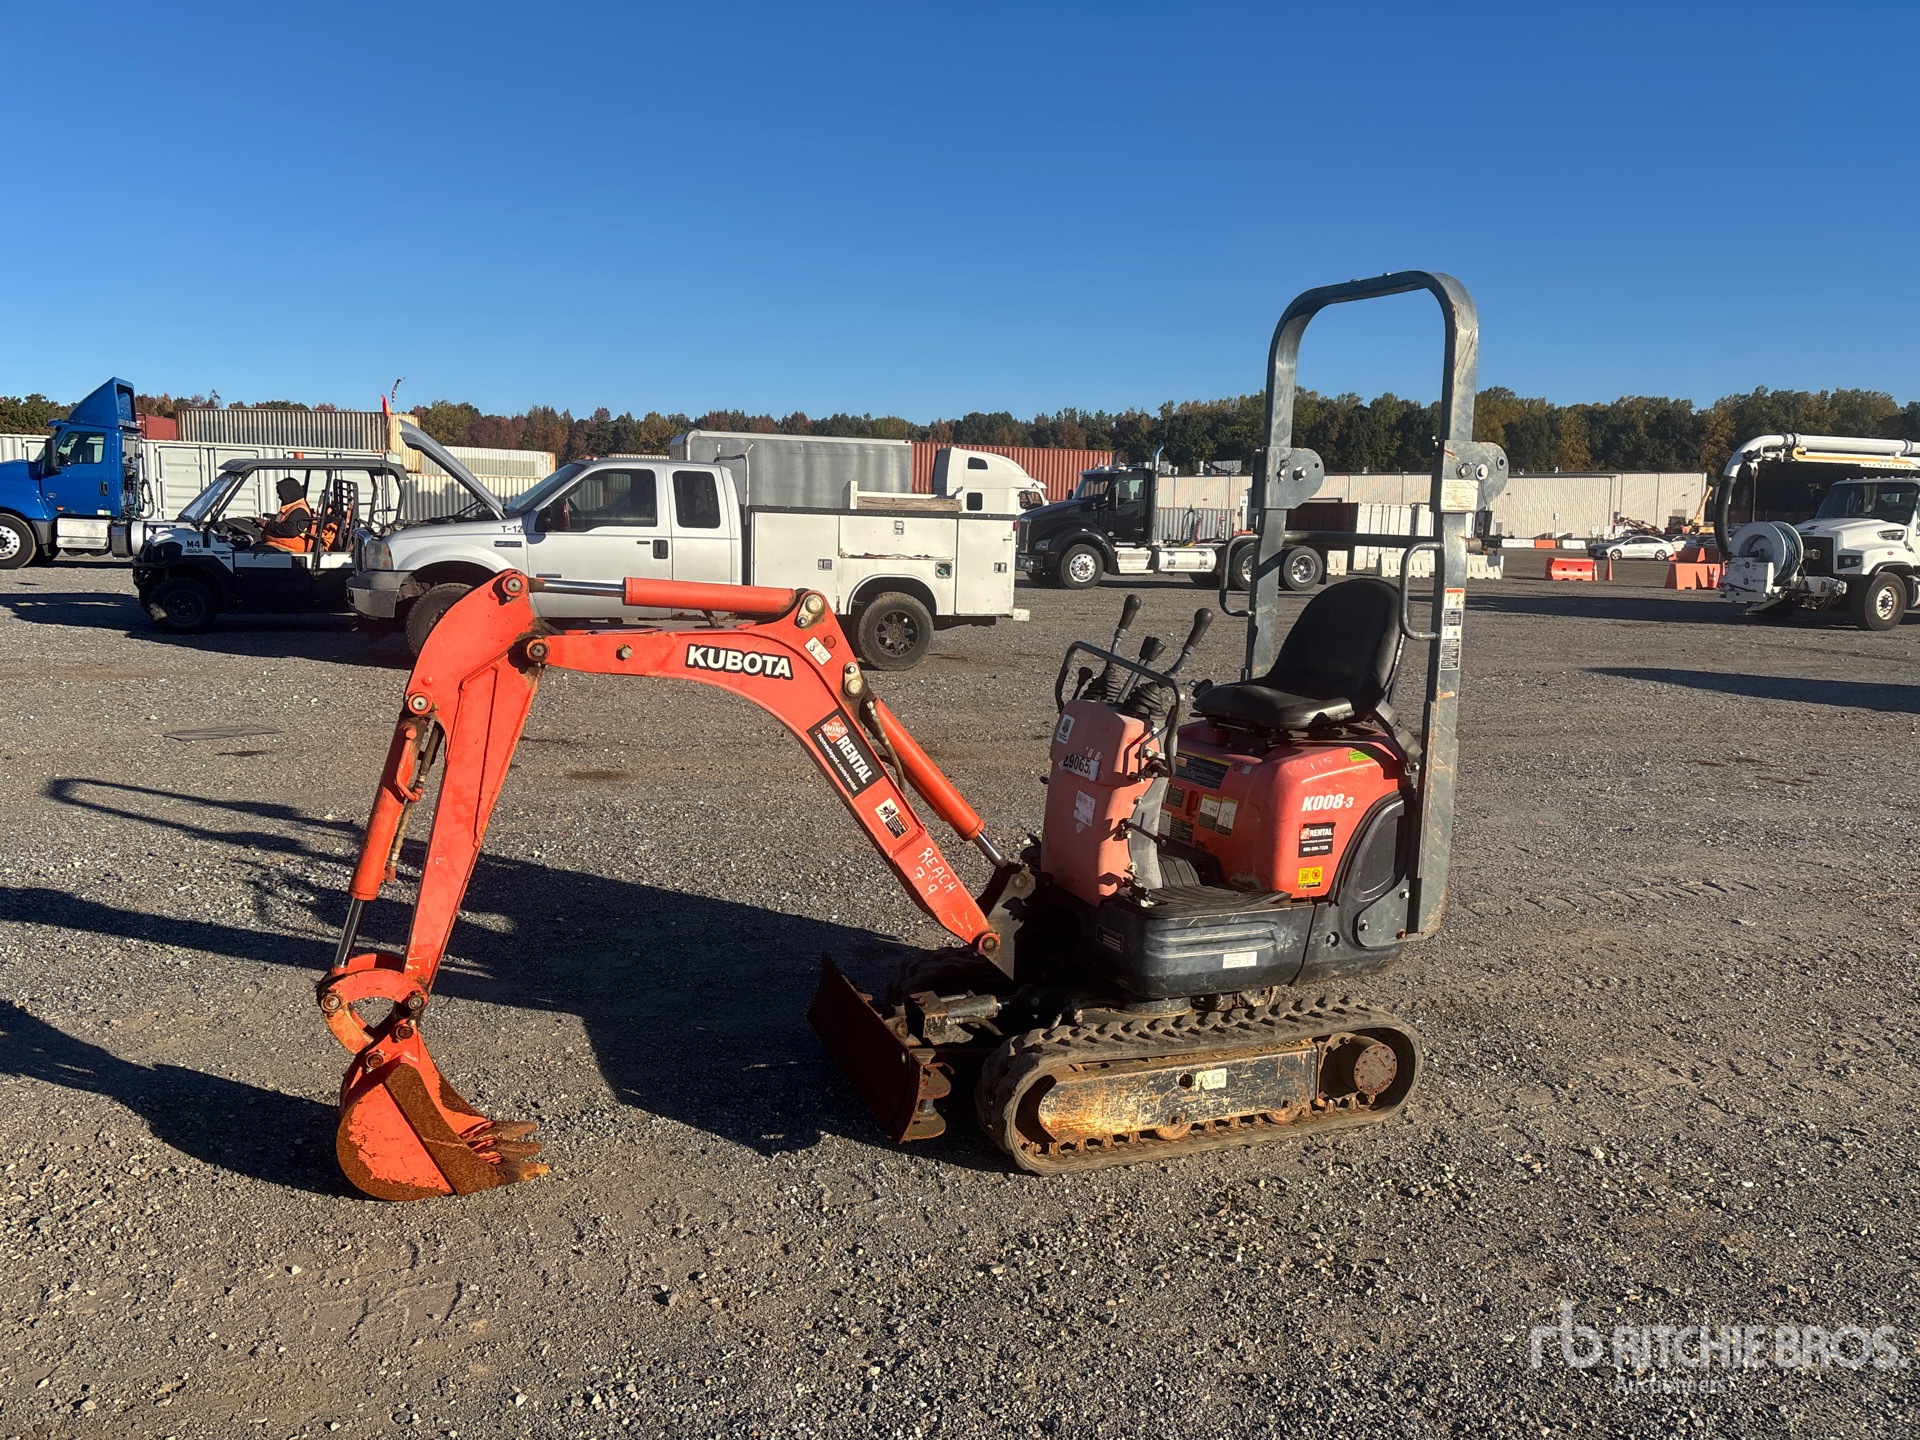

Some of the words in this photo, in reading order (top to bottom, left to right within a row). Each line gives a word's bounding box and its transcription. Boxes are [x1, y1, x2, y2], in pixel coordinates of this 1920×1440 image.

[501, 525, 523, 533] T-12
[186, 540, 201, 548] M4
[687, 645, 792, 678] KUBOTA
[824, 724, 845, 734] HOME
[817, 733, 858, 791] homedepot.com/rental
[836, 735, 872, 784] RENTAL
[1063, 754, 1091, 775] 29065
[1301, 793, 1354, 812] K008-3
[1309, 828, 1333, 837] RENTAL
[918, 847, 957, 893] REACH
